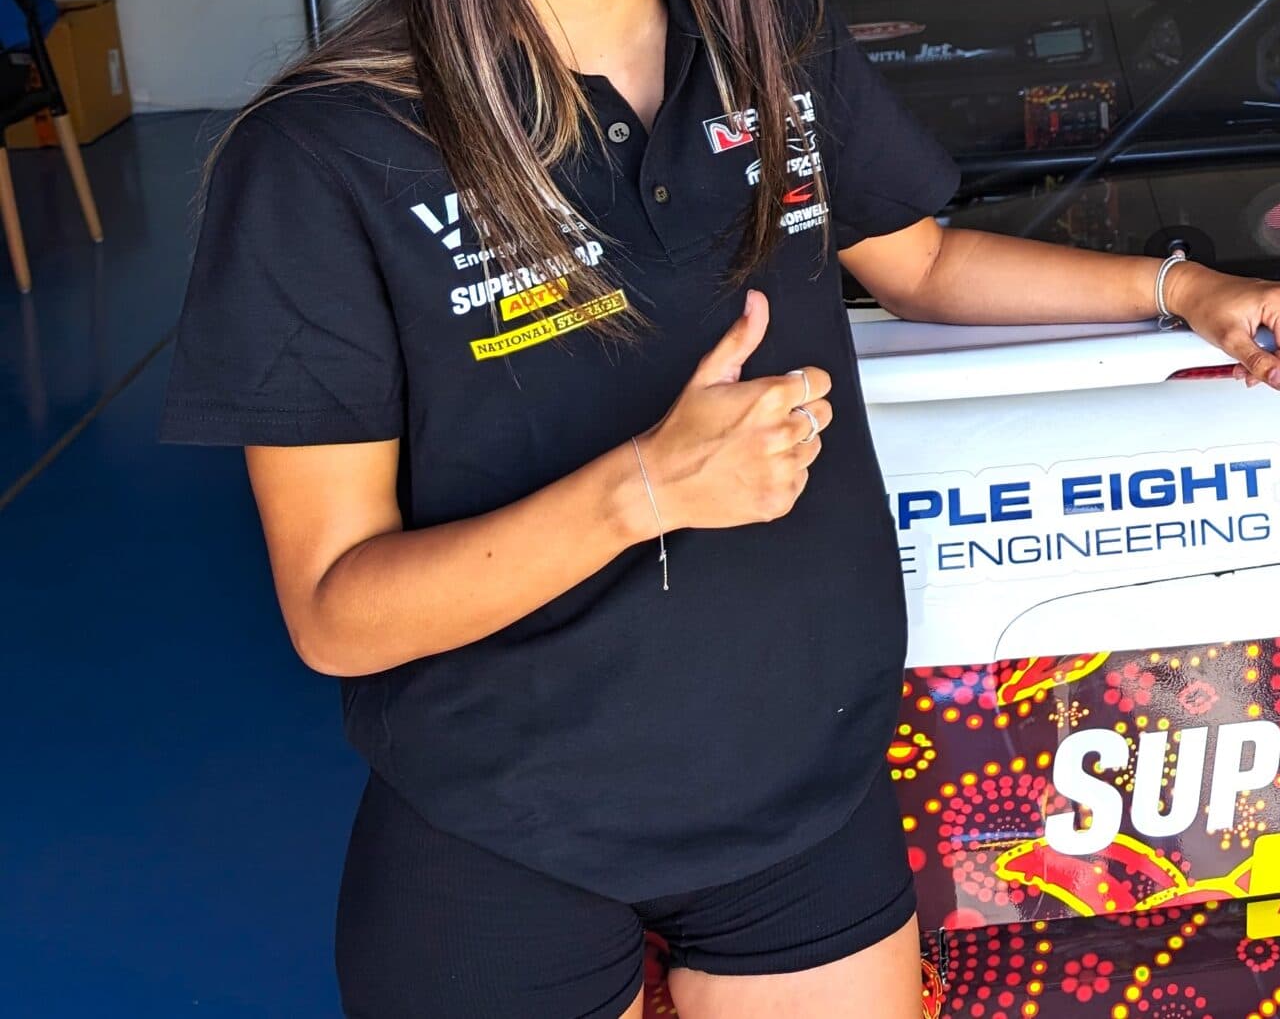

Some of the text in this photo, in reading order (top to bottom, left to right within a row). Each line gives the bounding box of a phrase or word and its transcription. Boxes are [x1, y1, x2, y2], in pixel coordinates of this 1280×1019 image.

[477, 324, 551, 355] NATIONAL
[886, 459, 1272, 530] PLE EIGHT
[938, 513, 1271, 572] ENGINEERING
